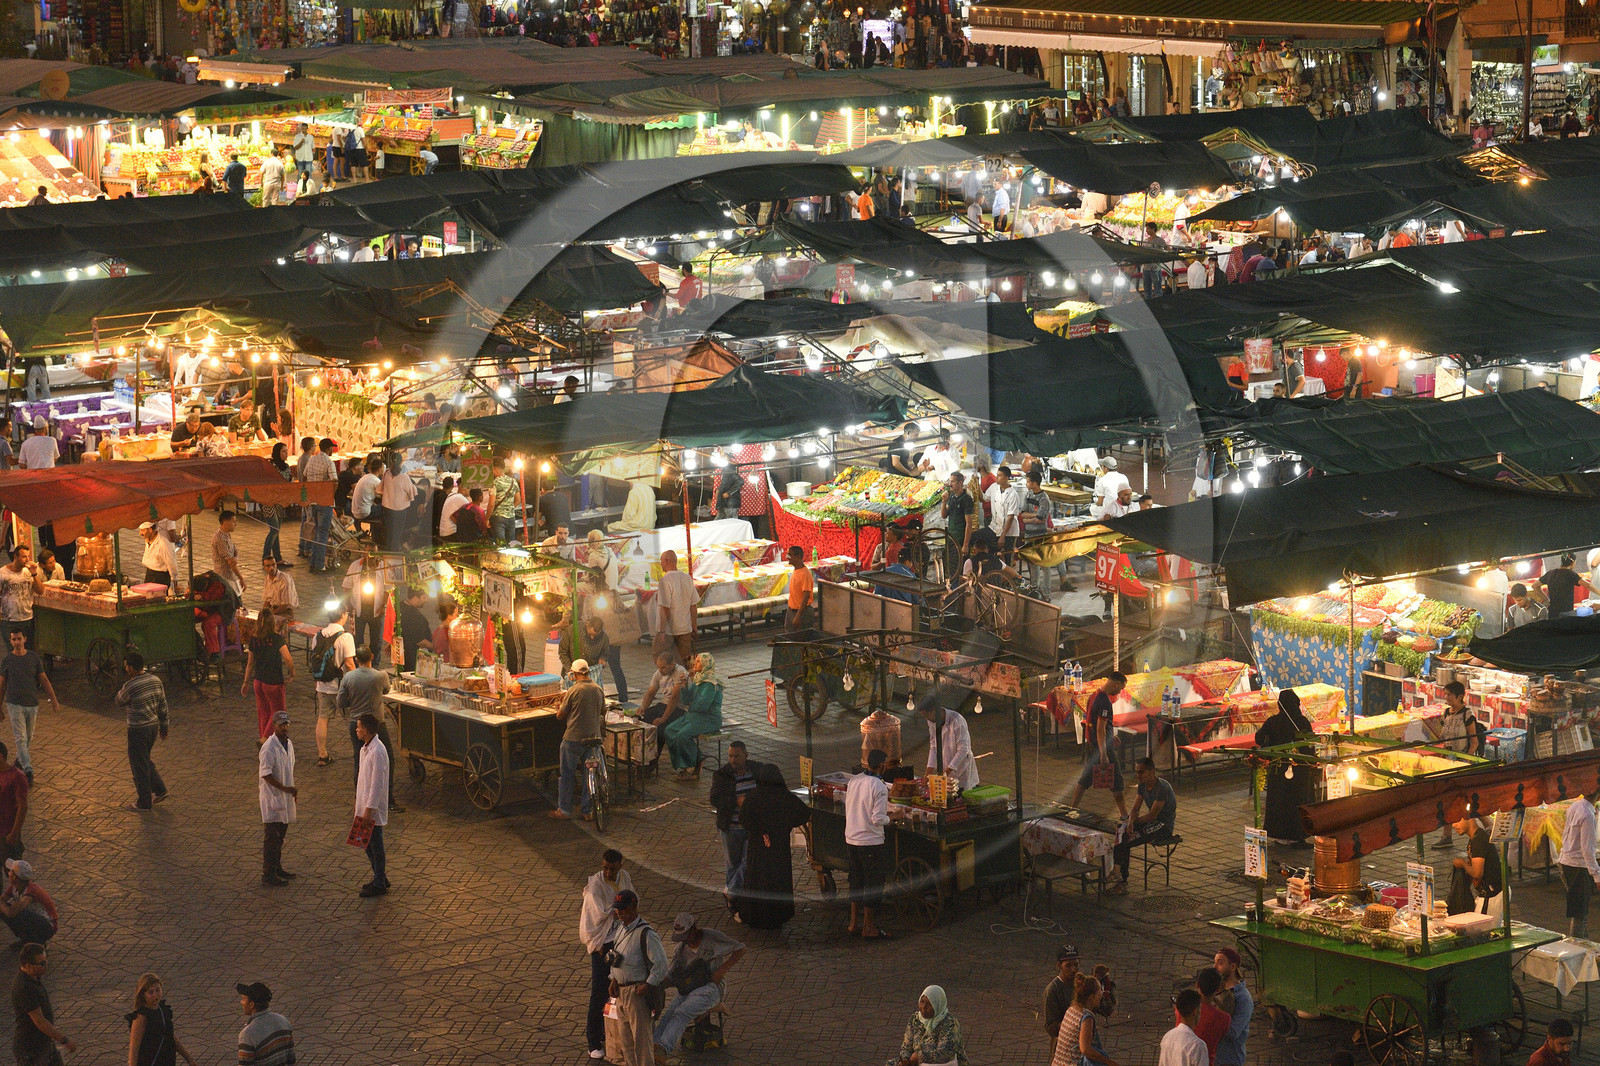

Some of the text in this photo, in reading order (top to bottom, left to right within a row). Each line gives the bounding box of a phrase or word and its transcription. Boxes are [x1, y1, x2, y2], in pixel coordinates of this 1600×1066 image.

[1022, 18, 1055, 29] RESTAURANT
[1063, 20, 1085, 31] GLACIER
[987, 158, 1002, 173] 22
[839, 275, 854, 284] N°1
[694, 284, 701, 299] 7
[467, 465, 491, 483] 29
[1098, 555, 1117, 580] 97
